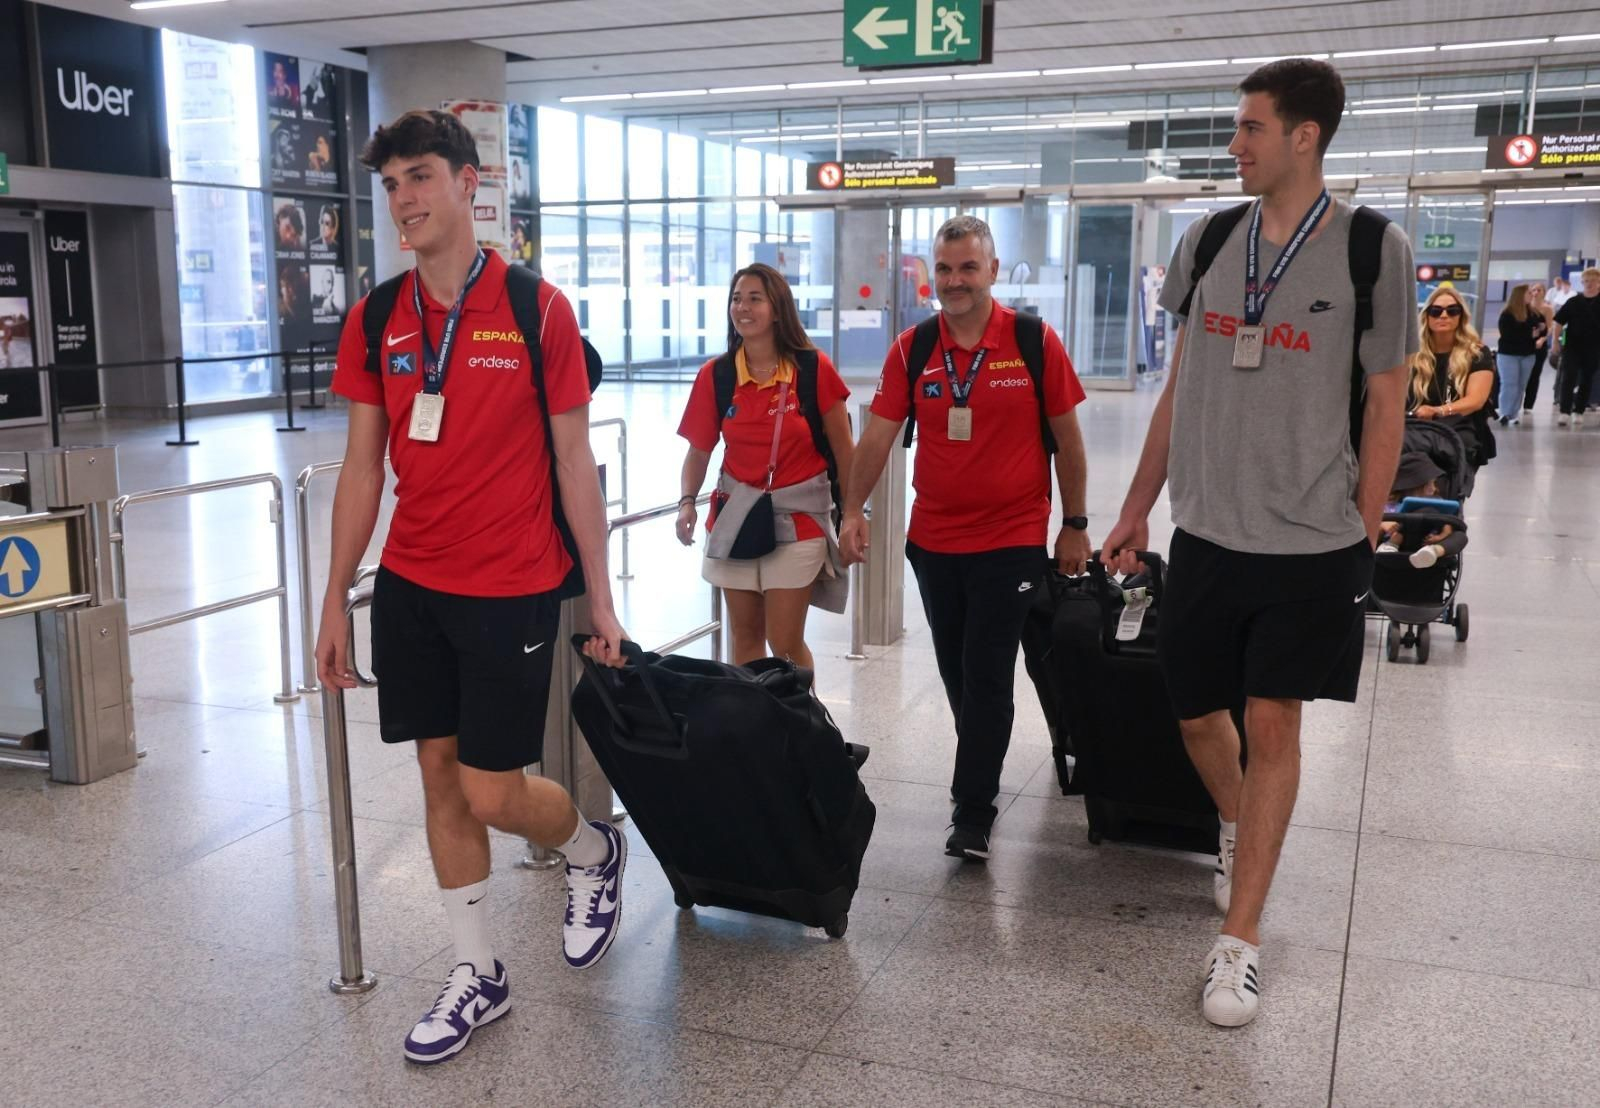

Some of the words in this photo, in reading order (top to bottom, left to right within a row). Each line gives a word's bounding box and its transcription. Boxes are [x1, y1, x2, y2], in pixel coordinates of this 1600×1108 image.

[57, 67, 134, 117] Uber
[1542, 135, 1557, 144] Nur
[1559, 133, 1595, 143] Personal
[1541, 144, 1584, 153] Authorized
[1586, 144, 1600, 152] per
[1541, 153, 1563, 164] Sólo
[1566, 153, 1600, 164] person
[844, 162, 855, 170] Nur
[856, 162, 882, 170] Personal
[862, 177, 895, 187] personal
[896, 176, 937, 185] autorizado
[50, 235, 80, 252] Uber
[0, 275, 17, 286] rola
[1204, 311, 1311, 352] ESÑA
[473, 331, 525, 344] ESPAÑA
[468, 355, 519, 370] endesa
[989, 378, 1028, 388] endesa
